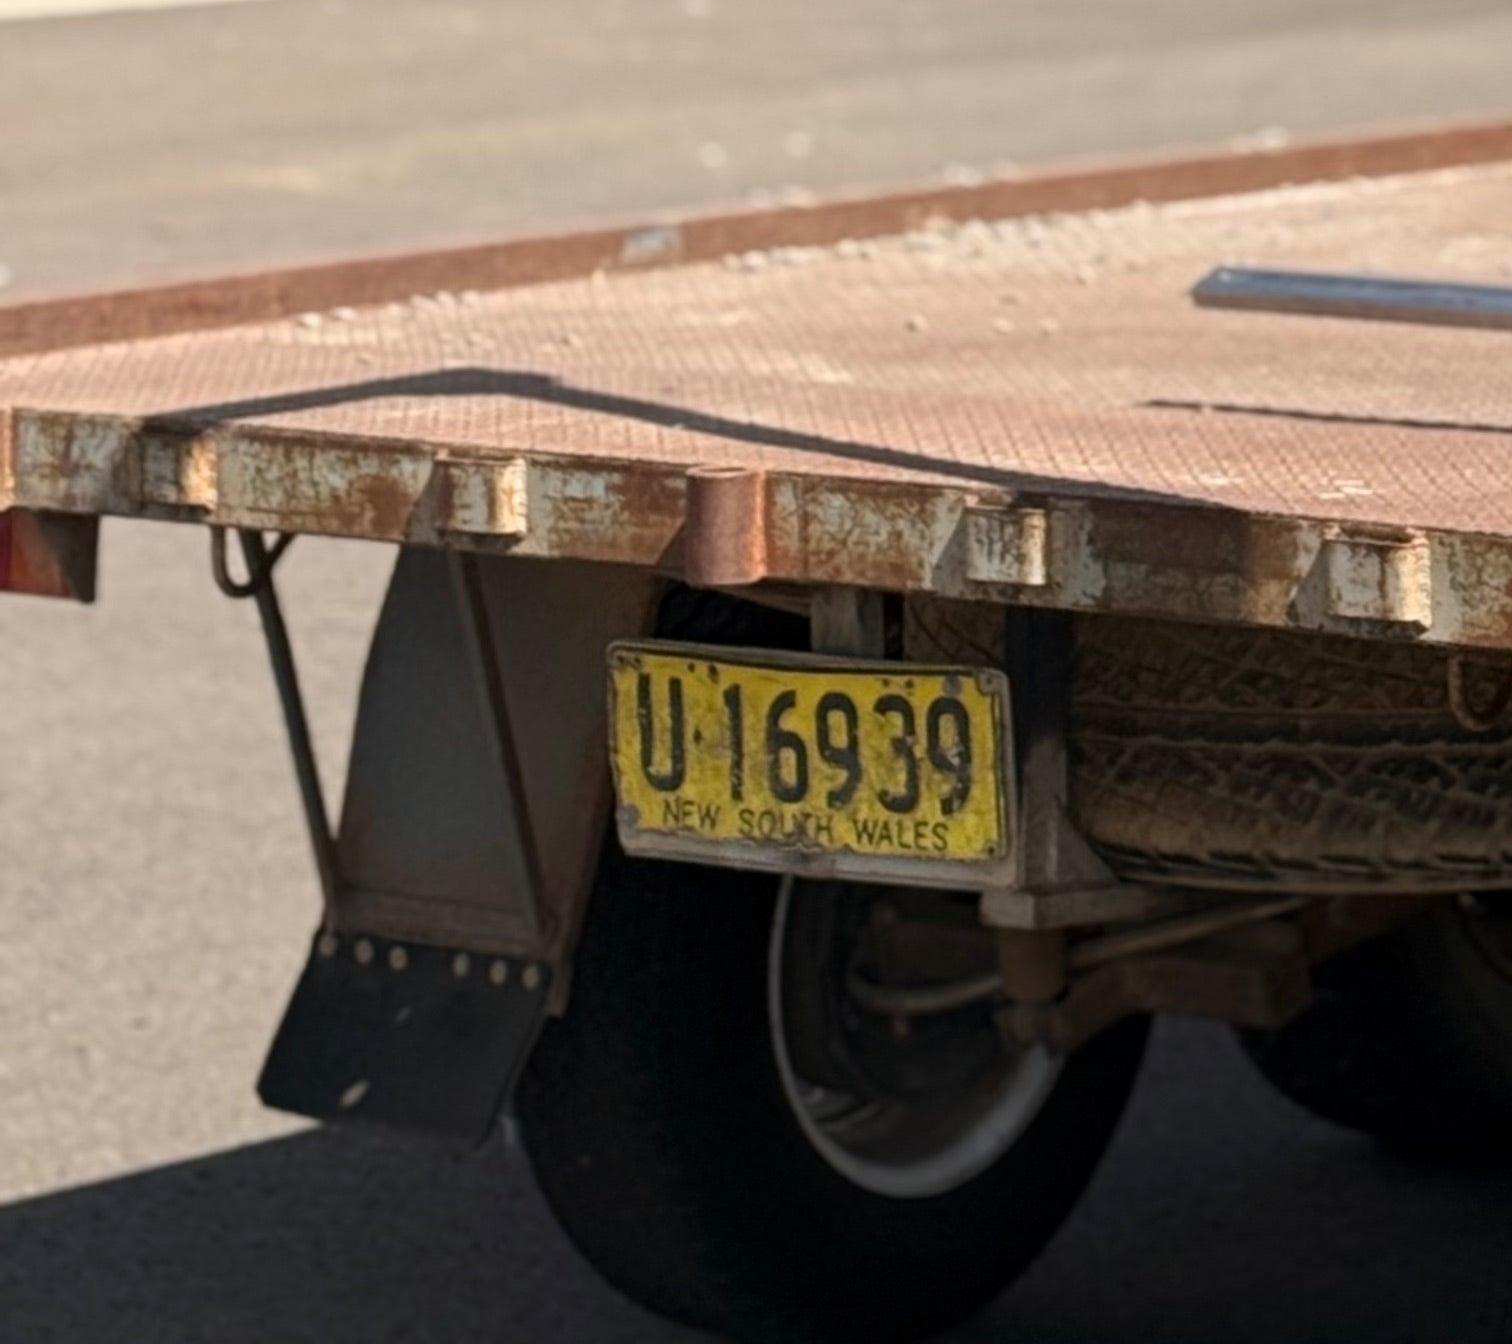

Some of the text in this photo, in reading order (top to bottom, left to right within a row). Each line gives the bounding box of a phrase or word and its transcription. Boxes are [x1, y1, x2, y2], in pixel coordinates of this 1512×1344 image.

[662, 798, 950, 852] NEW SOUTH WALES
